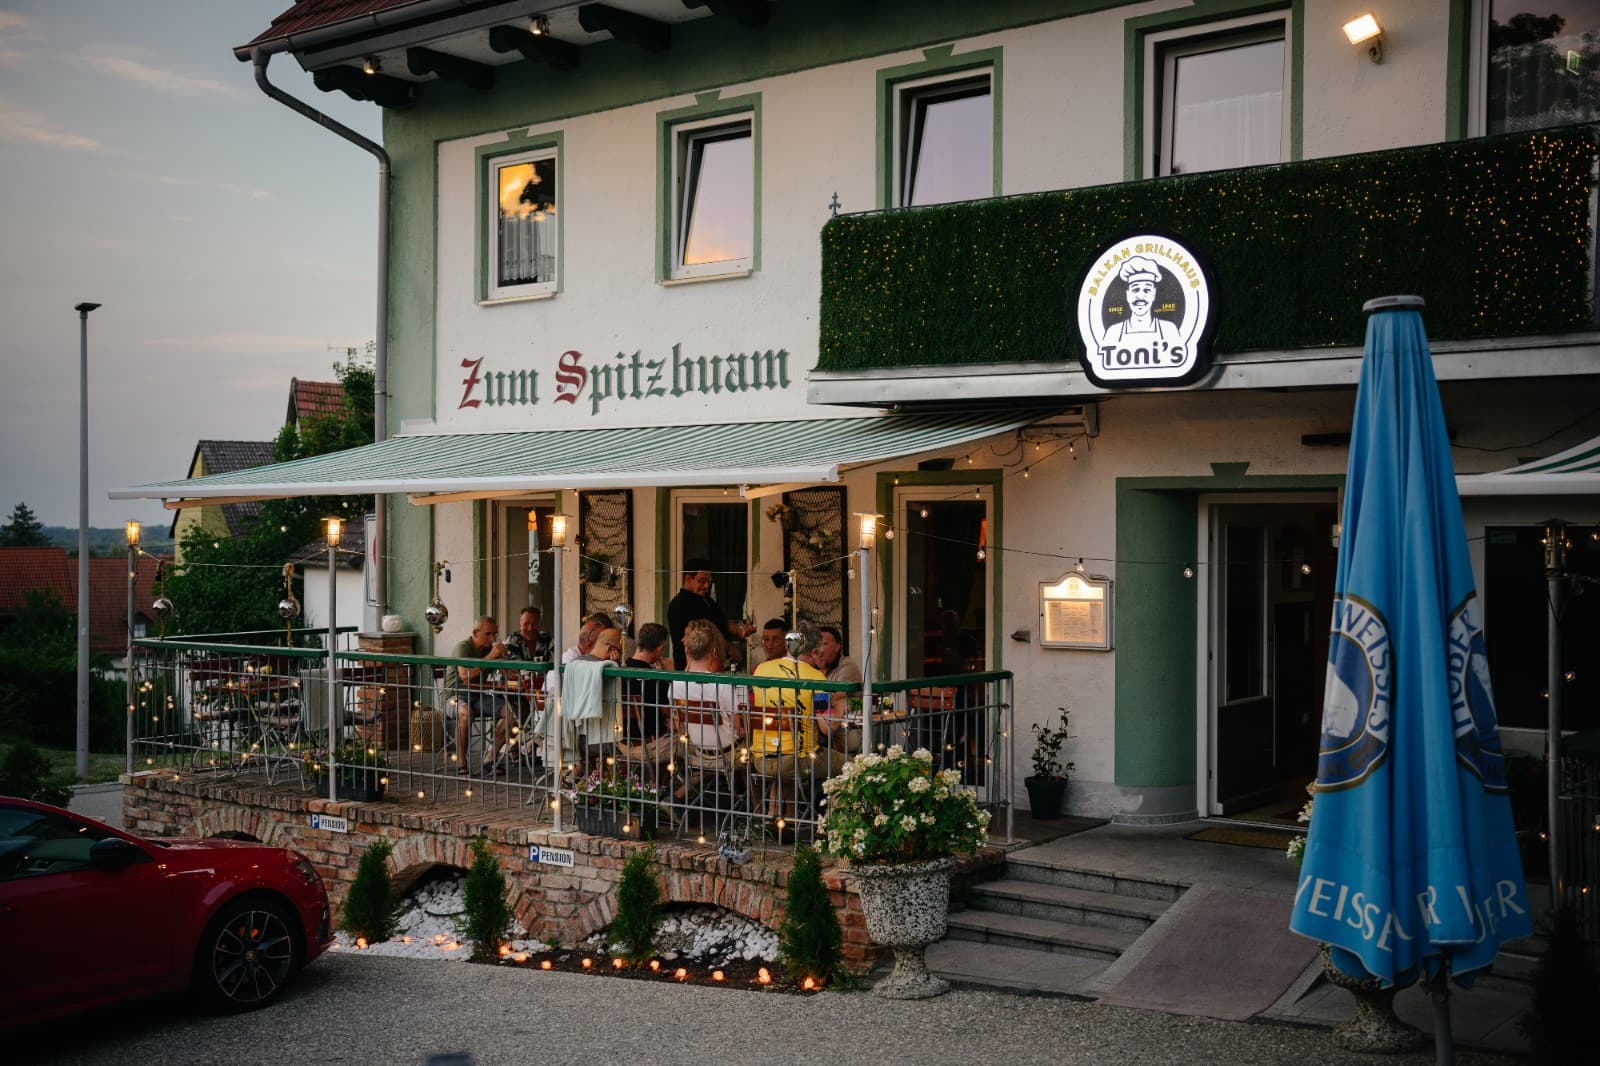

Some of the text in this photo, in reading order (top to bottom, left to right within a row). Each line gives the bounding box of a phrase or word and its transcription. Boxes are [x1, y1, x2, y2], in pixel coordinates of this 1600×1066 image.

[1088, 243, 1200, 296] BALKAN GRILLHAUS
[1101, 341, 1184, 366] Toni's
[458, 342, 791, 416] Zum Spitzbuam
[541, 850, 573, 865] PENSION
